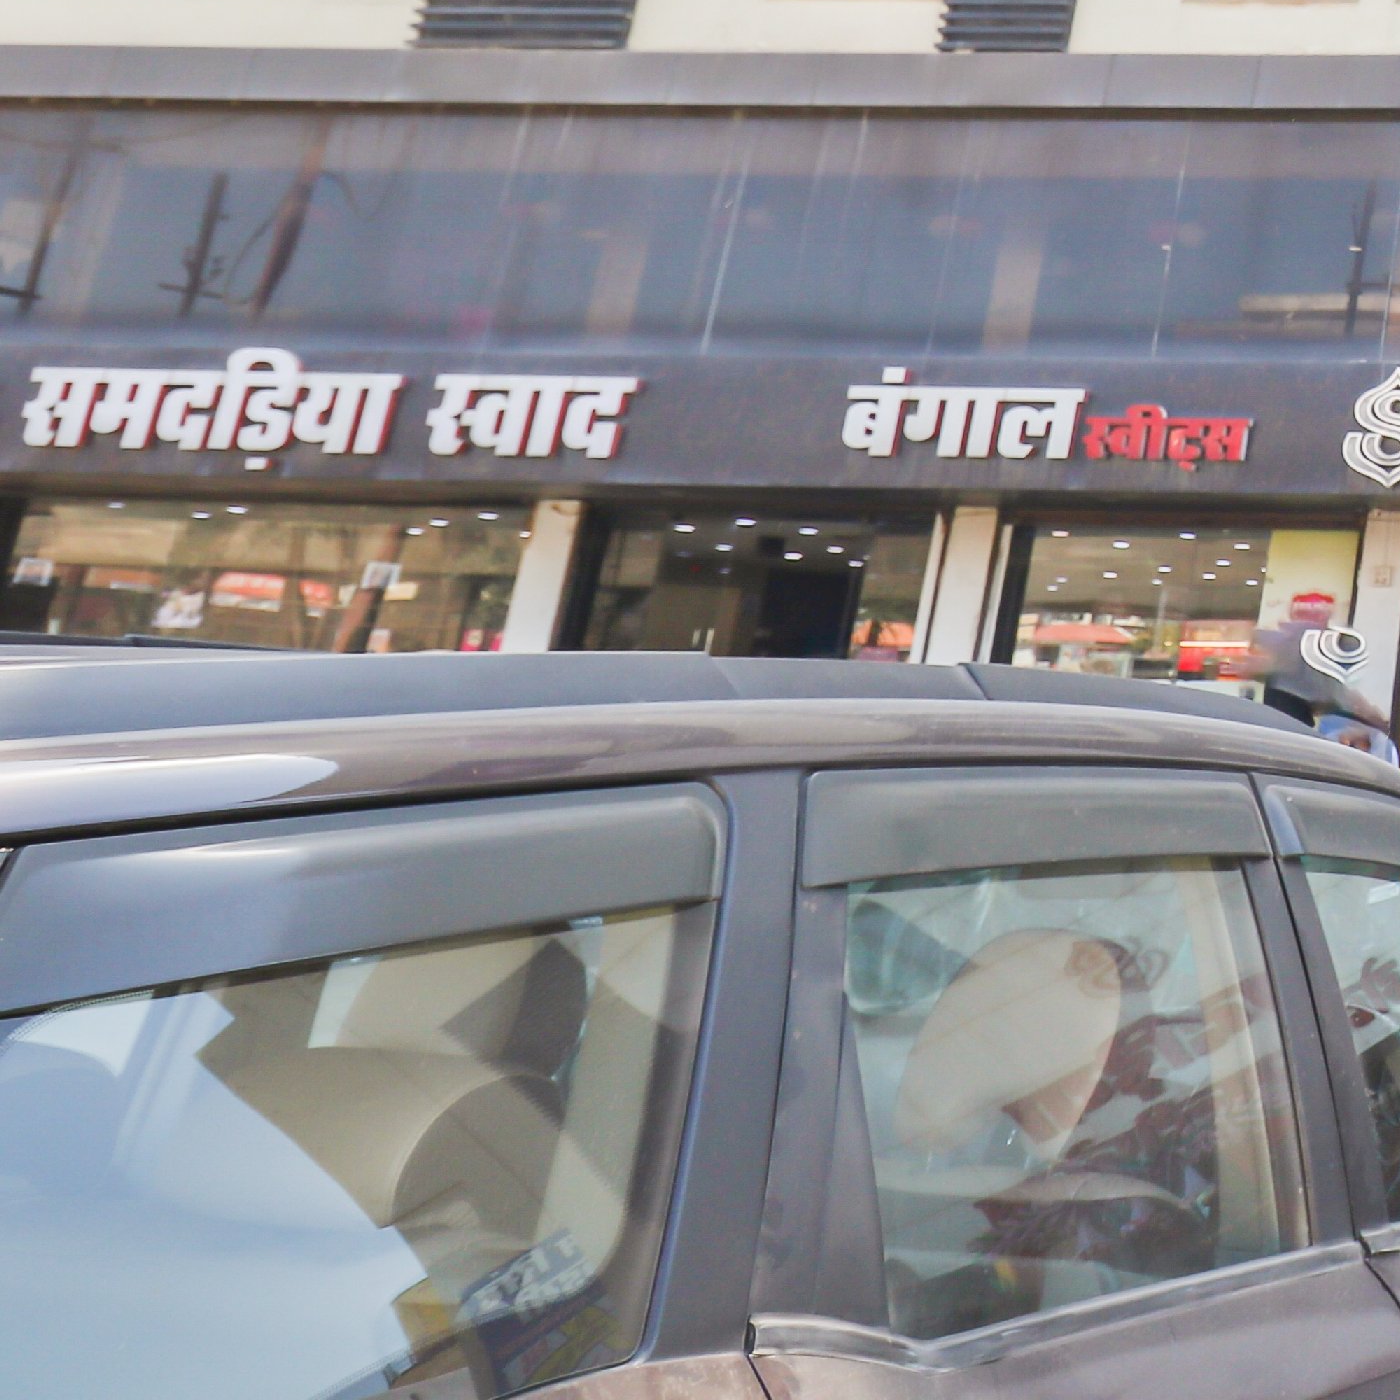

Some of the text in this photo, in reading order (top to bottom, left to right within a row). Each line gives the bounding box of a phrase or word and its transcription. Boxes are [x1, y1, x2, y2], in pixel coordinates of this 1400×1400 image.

[22, 347, 644, 471] समदड़िया स्वाद
[842, 366, 1253, 470] बंगाल स्वीट्स
